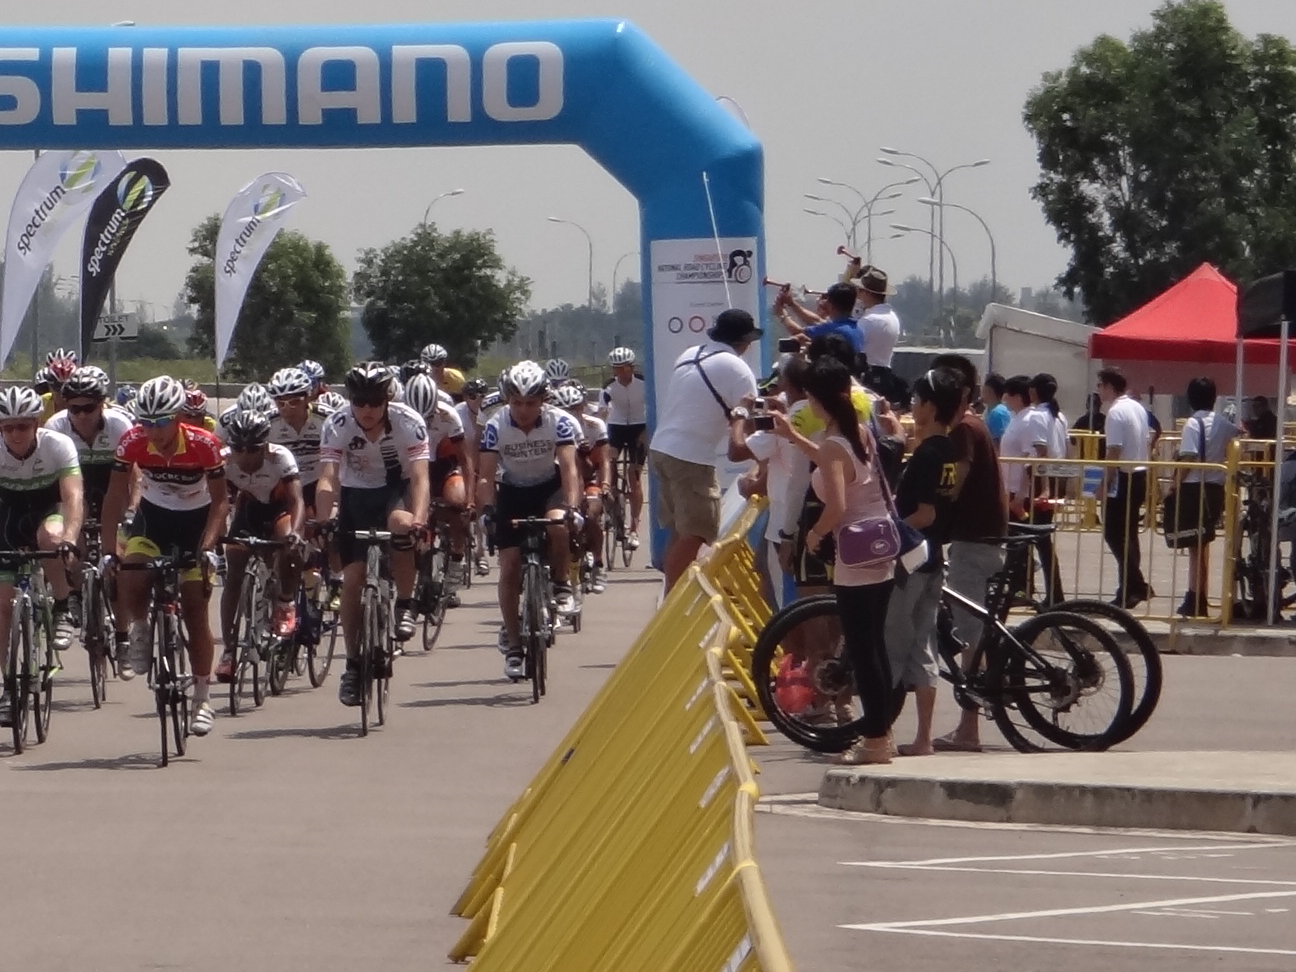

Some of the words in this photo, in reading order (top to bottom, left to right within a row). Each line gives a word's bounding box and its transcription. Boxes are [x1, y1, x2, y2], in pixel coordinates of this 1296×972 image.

[17, 184, 67, 257] spectrum
[87, 208, 127, 277] spectrum
[224, 216, 262, 278] spectrum
